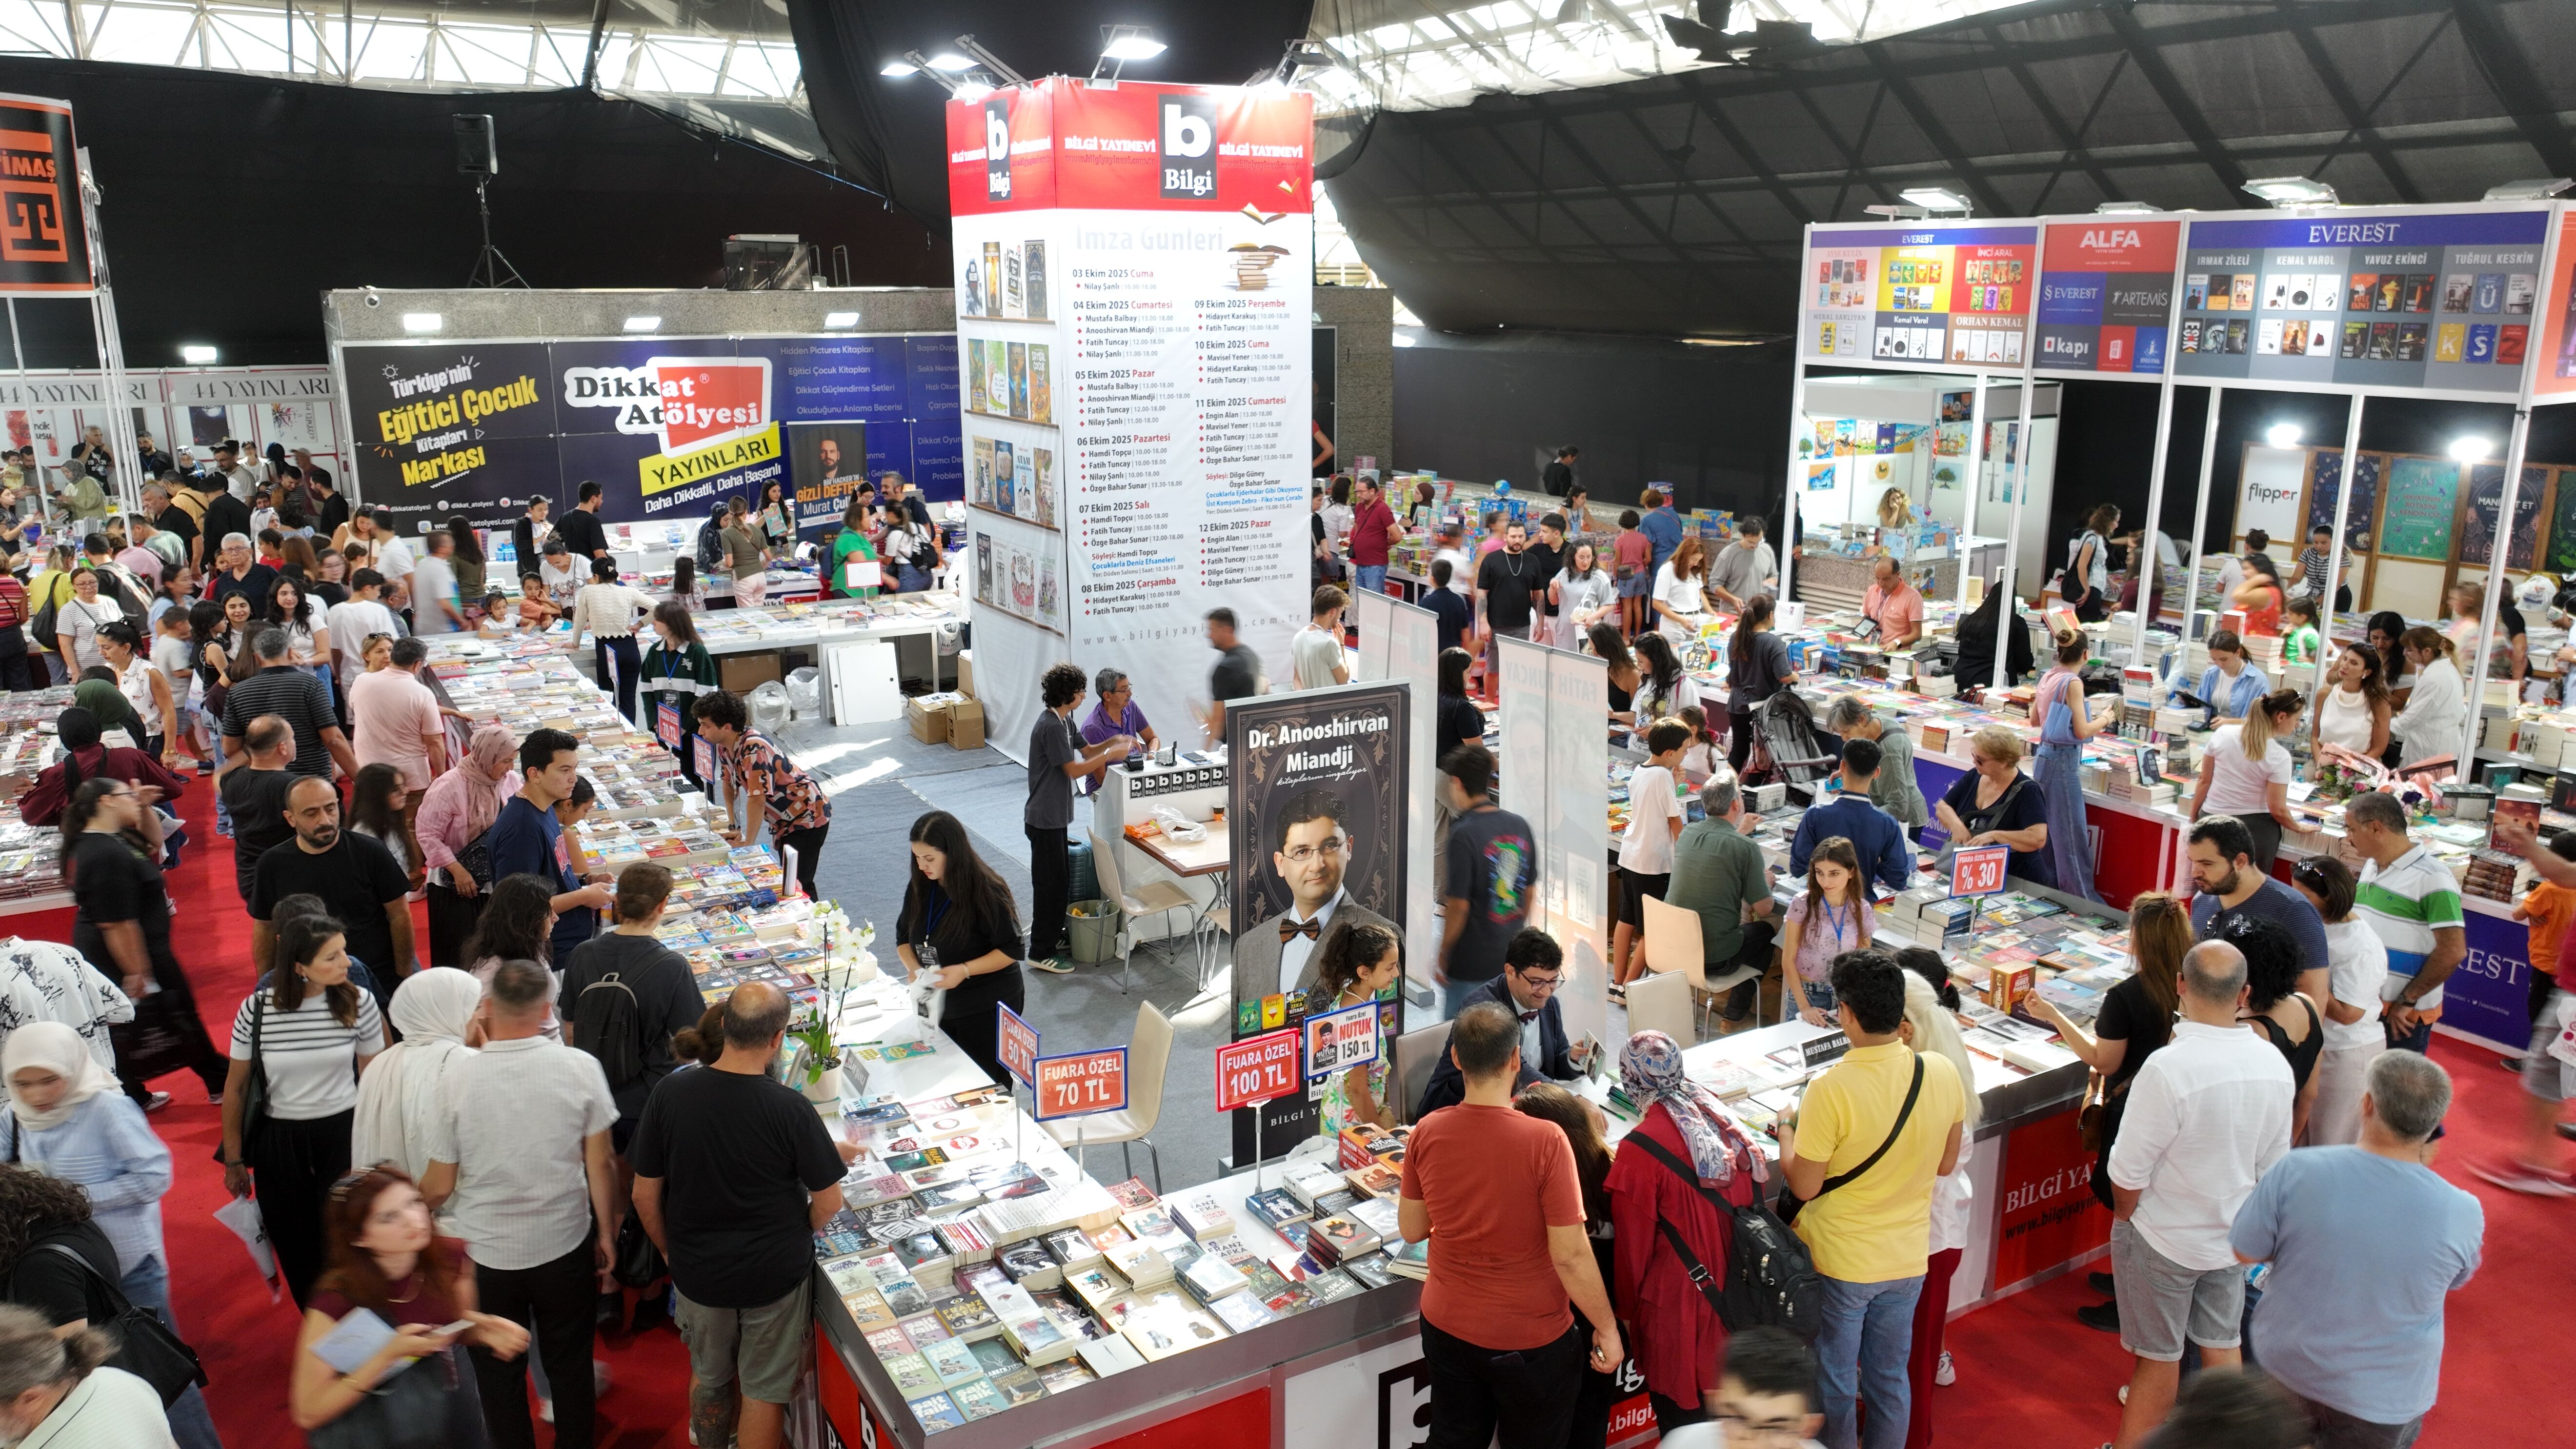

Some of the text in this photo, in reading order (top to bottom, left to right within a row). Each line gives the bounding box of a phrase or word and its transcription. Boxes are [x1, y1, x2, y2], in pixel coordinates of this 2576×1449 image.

[1165, 104, 1211, 158] b
[1064, 135, 1098, 150] BİLGİ
[1100, 139, 1156, 152] YAYINEVİ
[1219, 142, 1303, 158] BİLGİ YAYINEVİ
[0, 150, 56, 183] İMAŞ
[1165, 169, 1213, 196] Bilgi
[1141, 226, 1222, 250] Günleri
[2079, 230, 2141, 248] ALFA
[1978, 248, 1992, 257] İNCİ
[2197, 254, 2250, 265] IRMAK ZİLELİ
[2277, 255, 2335, 266] KEMAL VAROL
[2365, 252, 2427, 264] YAVUZ EKİNCİ
[2455, 252, 2534, 264] TUĞRUL KESKİN
[2121, 289, 2168, 306] ARTEMİS
[1956, 317, 2023, 327] ORHAN KEMAL
[781, 347, 808, 355] Hidden
[843, 346, 874, 354] Kitapları
[2057, 337, 2088, 358] kapı
[191, 378, 329, 398] 44 YAYINLARI
[390, 364, 472, 399] Türkiye'nin
[574, 377, 695, 398] Dikkat
[822, 385, 869, 395] Güçlendirme
[379, 375, 539, 445] Eğitici Çocuk
[625, 402, 759, 428] Atölyesi
[797, 405, 842, 415] Okuduğunu
[416, 429, 467, 453] Kitapları
[401, 446, 485, 486] Markası
[652, 438, 770, 485] YAYINLARI
[645, 463, 781, 514] Daha Dikkatli, Daha Başarılı
[796, 484, 821, 503] GİZLİ
[2249, 483, 2297, 504] flipper
[804, 501, 830, 516] Murat
[1199, 524, 1208, 532] 12
[1210, 523, 1228, 531] Ekim
[1230, 521, 1248, 530] 2025
[1092, 561, 1125, 570] Çocuklarla
[1146, 556, 1175, 565] Efsaneleri
[1094, 584, 1114, 592] Ekim
[1116, 581, 1135, 590] 2025
[1137, 577, 1176, 589] Çarşamba
[1150, 590, 1180, 599] 10.00-18.00
[663, 722, 677, 741] 70 TL
[1249, 716, 1388, 749] Dr. Anooshirvan
[1286, 745, 1353, 773] Miandji
[1974, 854, 1985, 862] ÖZEL
[1986, 852, 2003, 861] İNDİRİM
[1962, 862, 1995, 890] % 30
[1004, 1017, 1037, 1055] FUARA ÖZEL
[1340, 1017, 1372, 1041] NUTUK
[1316, 1047, 1335, 1057] NUTUK
[1342, 1040, 1370, 1059] 150 TL
[1805, 1037, 1851, 1056] MUSTAFA BALBA
[1008, 1039, 1032, 1077] 50 TL
[1227, 1043, 1291, 1071] FUARA ÖZEL
[1045, 1058, 1120, 1081] FUARA ÖZEL
[1230, 1063, 1286, 1097] 100 TL
[1056, 1079, 1109, 1107] 70 TL
[1270, 1109, 1304, 1127] BİLGİ
[1343, 1137, 1357, 1151] NUTUK
[881, 1179, 897, 1194] ZWEIG
[888, 1177, 903, 1192] STEFAN
[2005, 1168, 2063, 1214] BİLGİ
[2006, 1195, 2097, 1240] www.bilgiyayin
[1323, 1280, 1355, 1301] MEMNU
[942, 1300, 983, 1315] FRANZ
[946, 1305, 986, 1320] KAFKA
[911, 1395, 946, 1410] sait
[916, 1402, 951, 1418] faik
